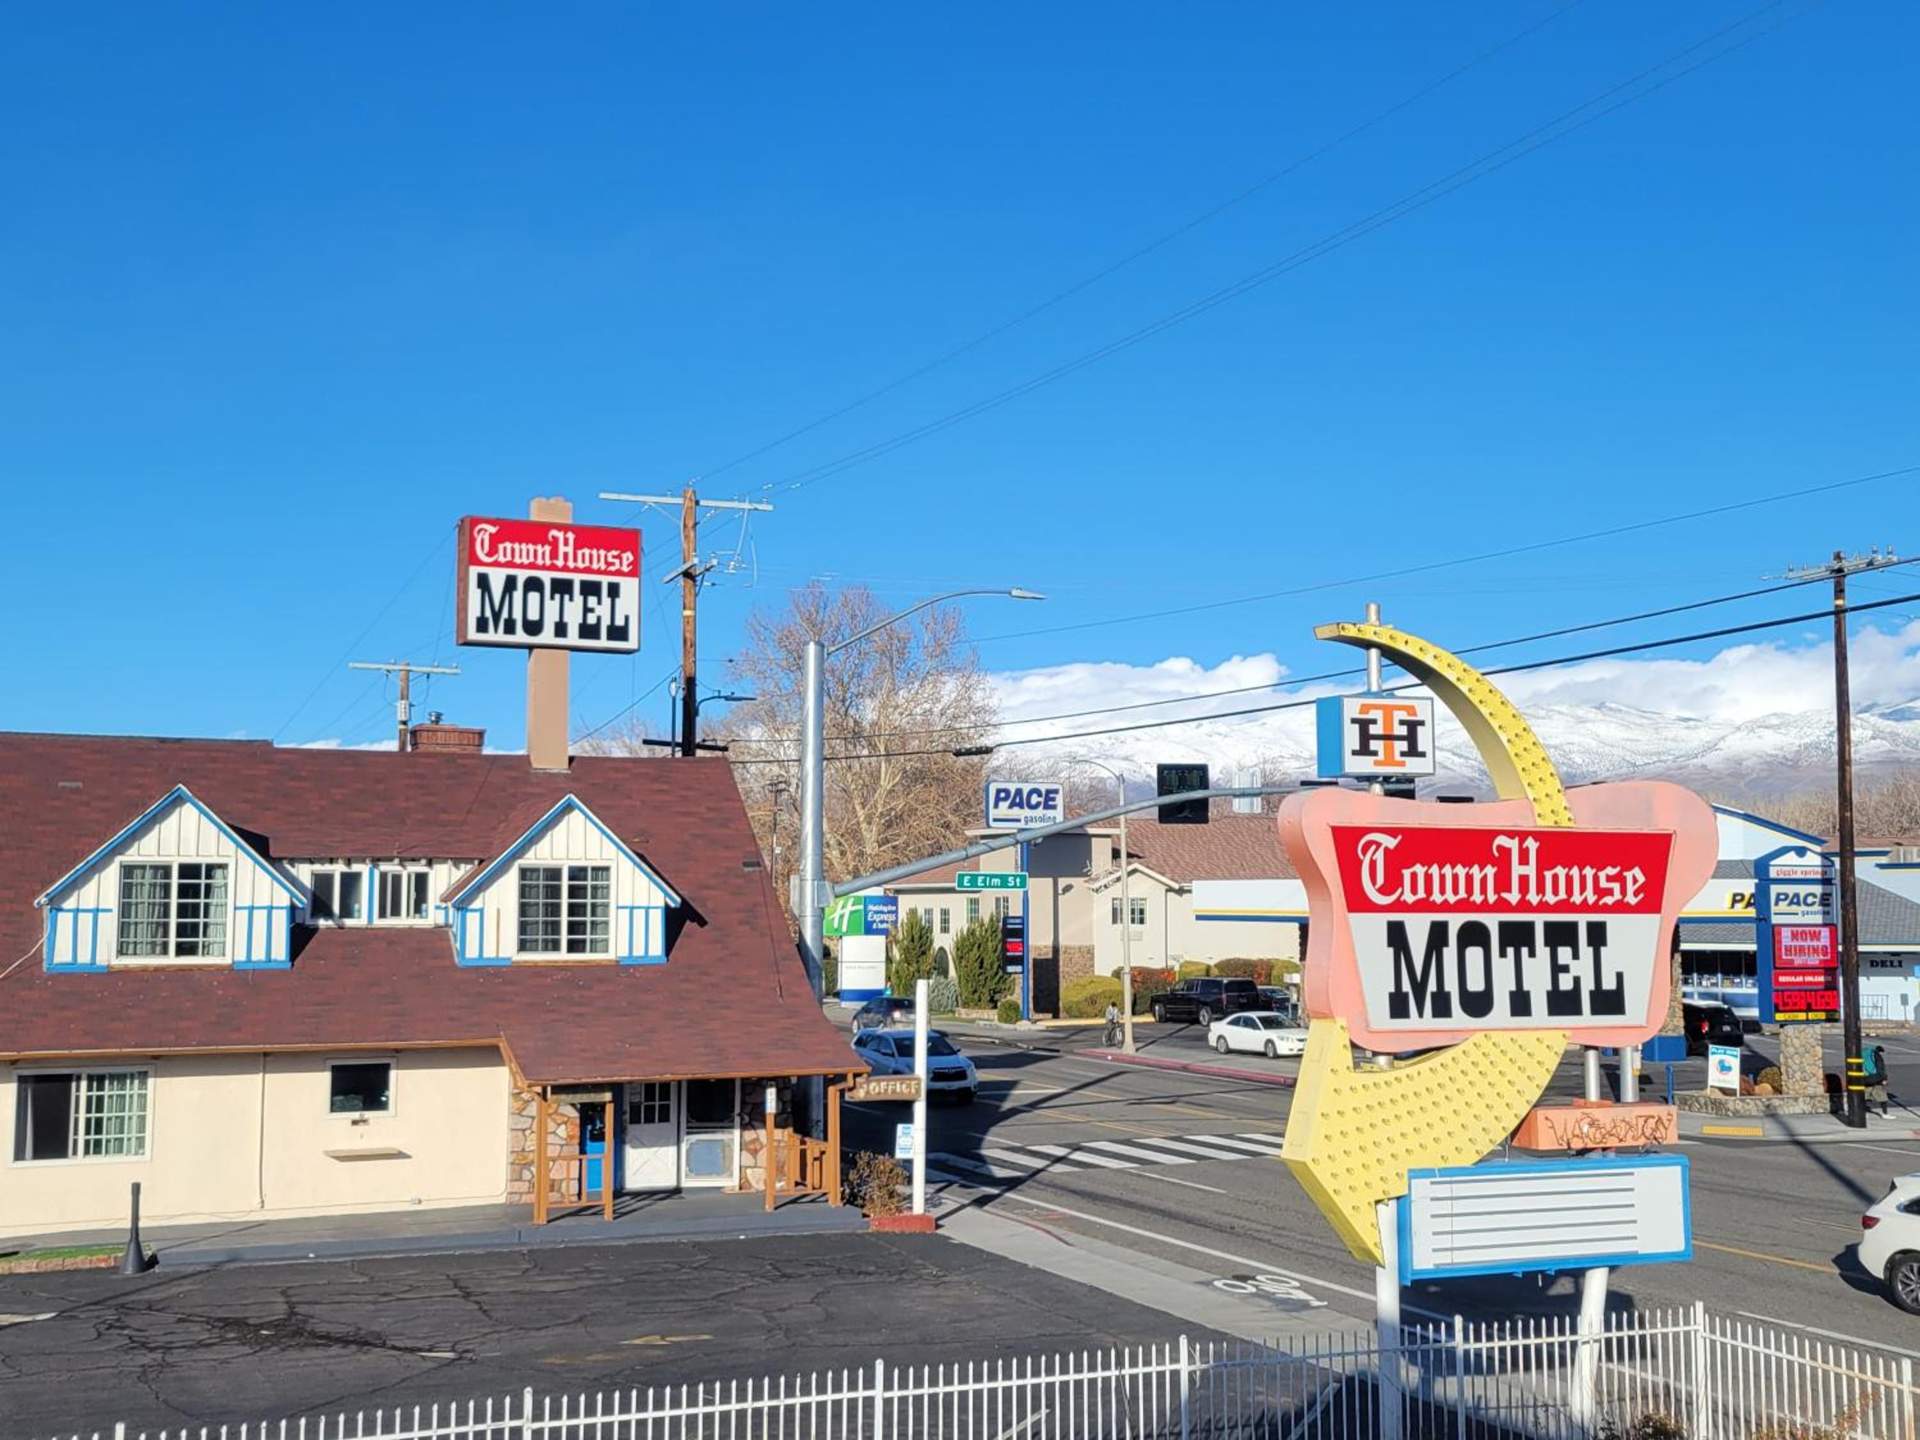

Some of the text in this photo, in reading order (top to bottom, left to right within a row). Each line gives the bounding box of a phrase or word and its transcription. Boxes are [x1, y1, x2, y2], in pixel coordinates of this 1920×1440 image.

[475, 572, 630, 642] MOTEL
[993, 787, 1060, 810] PACE
[1023, 814, 1057, 825] gasoline
[963, 876, 1021, 886] E Elm St
[1774, 892, 1832, 907] PACE
[867, 912, 896, 921] Express
[1790, 929, 1822, 942] NOW
[1784, 945, 1829, 957] HIRING
[1387, 920, 1626, 1019] MOTEL
[1870, 960, 1903, 968] DELI
